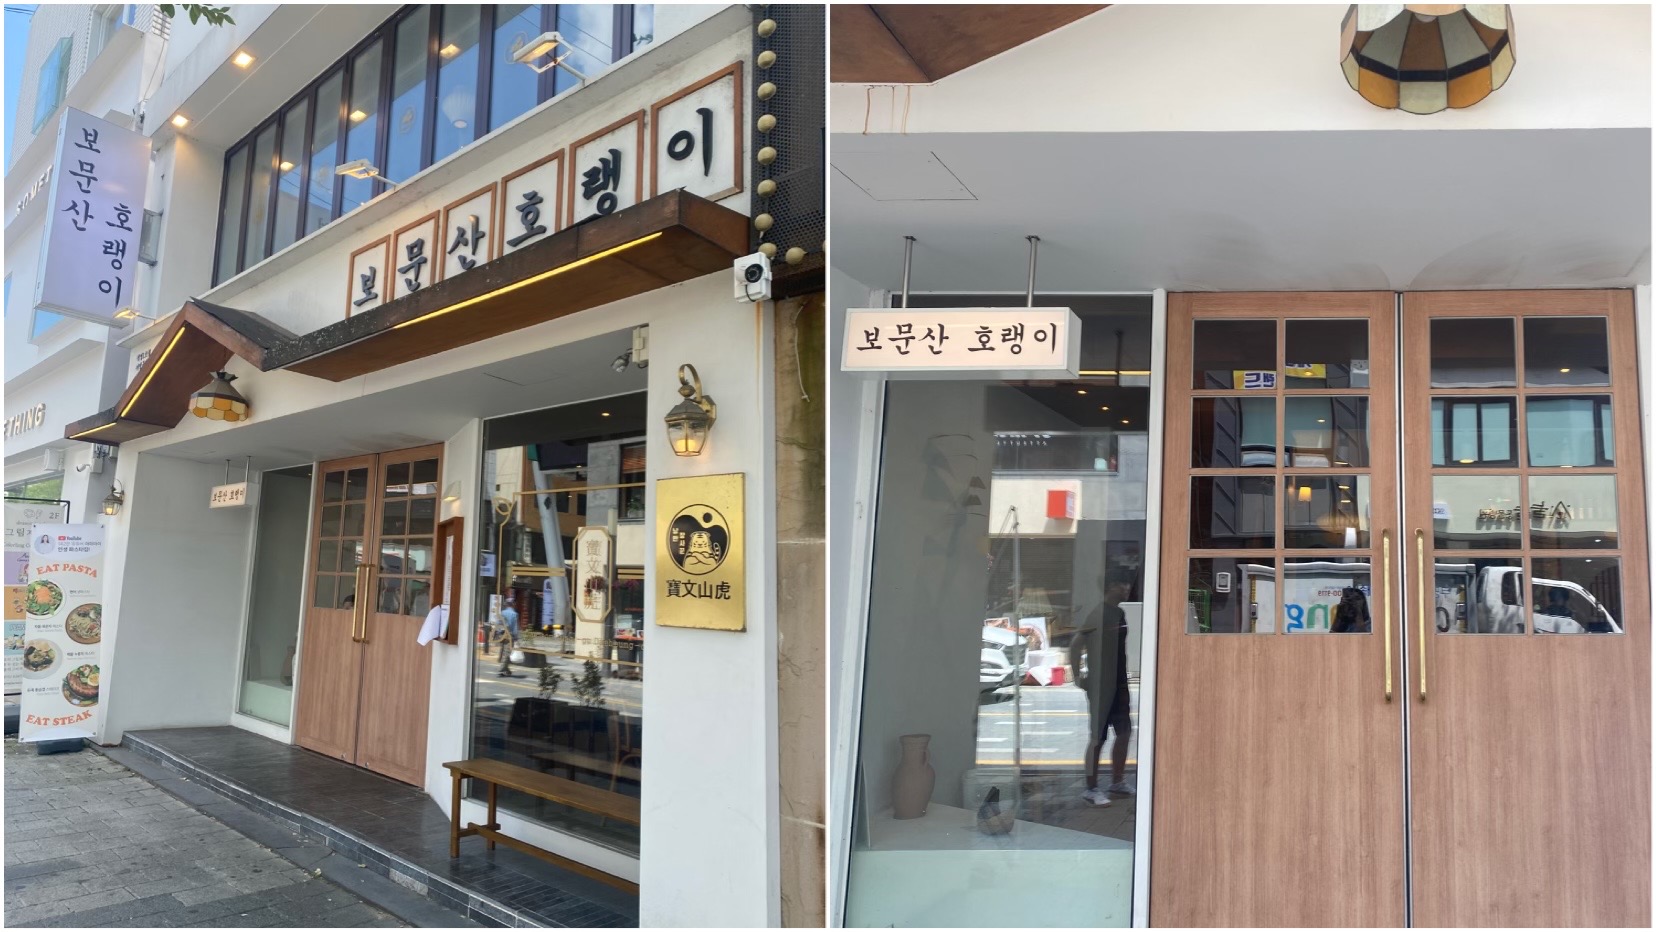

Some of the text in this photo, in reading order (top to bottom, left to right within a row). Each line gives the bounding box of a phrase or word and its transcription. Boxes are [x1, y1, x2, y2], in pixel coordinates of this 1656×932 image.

[62, 127, 101, 232] 보문산
[98, 203, 134, 308] 호랭이
[856, 321, 1058, 356] 보문산 호랭이
[36, 563, 98, 578] EAT PASTA
[666, 579, 731, 600] 寶文山虎
[26, 710, 93, 726] EAT STEAK
